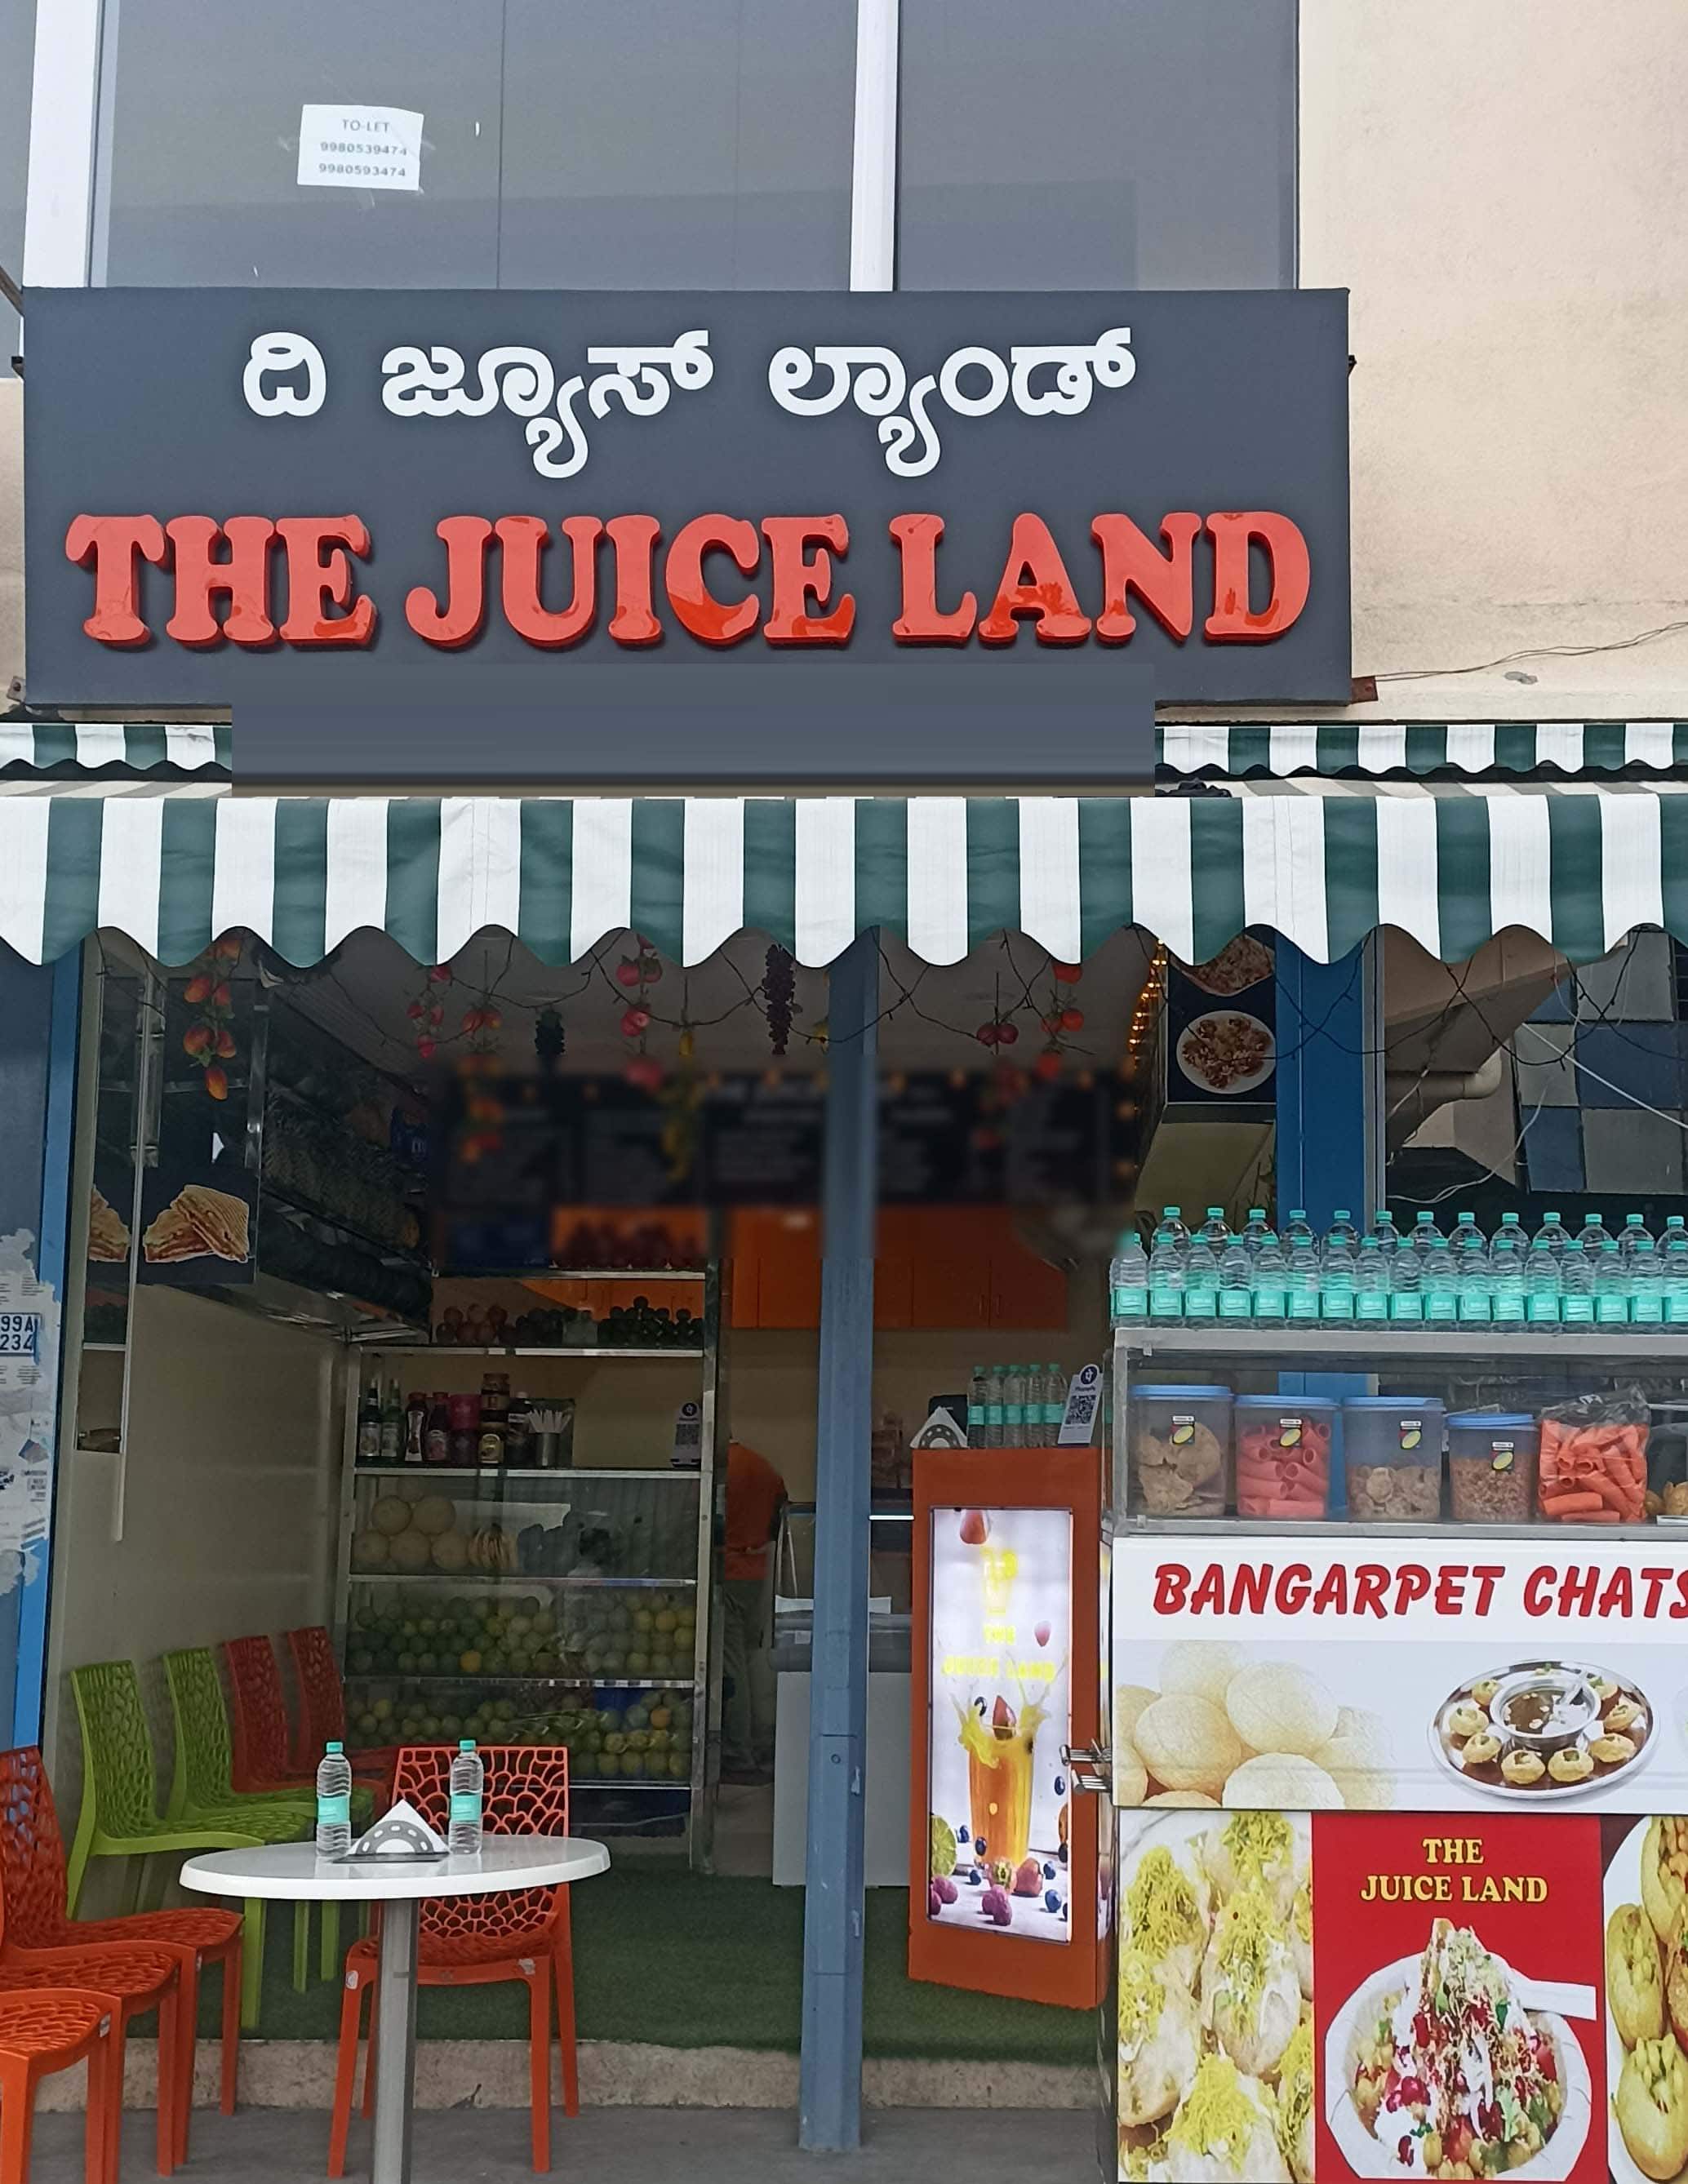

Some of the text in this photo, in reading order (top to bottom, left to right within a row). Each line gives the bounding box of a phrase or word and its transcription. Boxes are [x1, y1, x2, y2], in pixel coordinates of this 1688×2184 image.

[243, 327, 1136, 478] ದಿ ಜ್ಯೂಸ್ ಲ್ಯಾಂಡ್
[65, 511, 1311, 647] THE JUICE LAND
[1153, 1564, 1505, 1619] BANGARPET
[1423, 1838, 1484, 1864] THE
[1361, 1875, 1548, 1902] JUICE LAND
